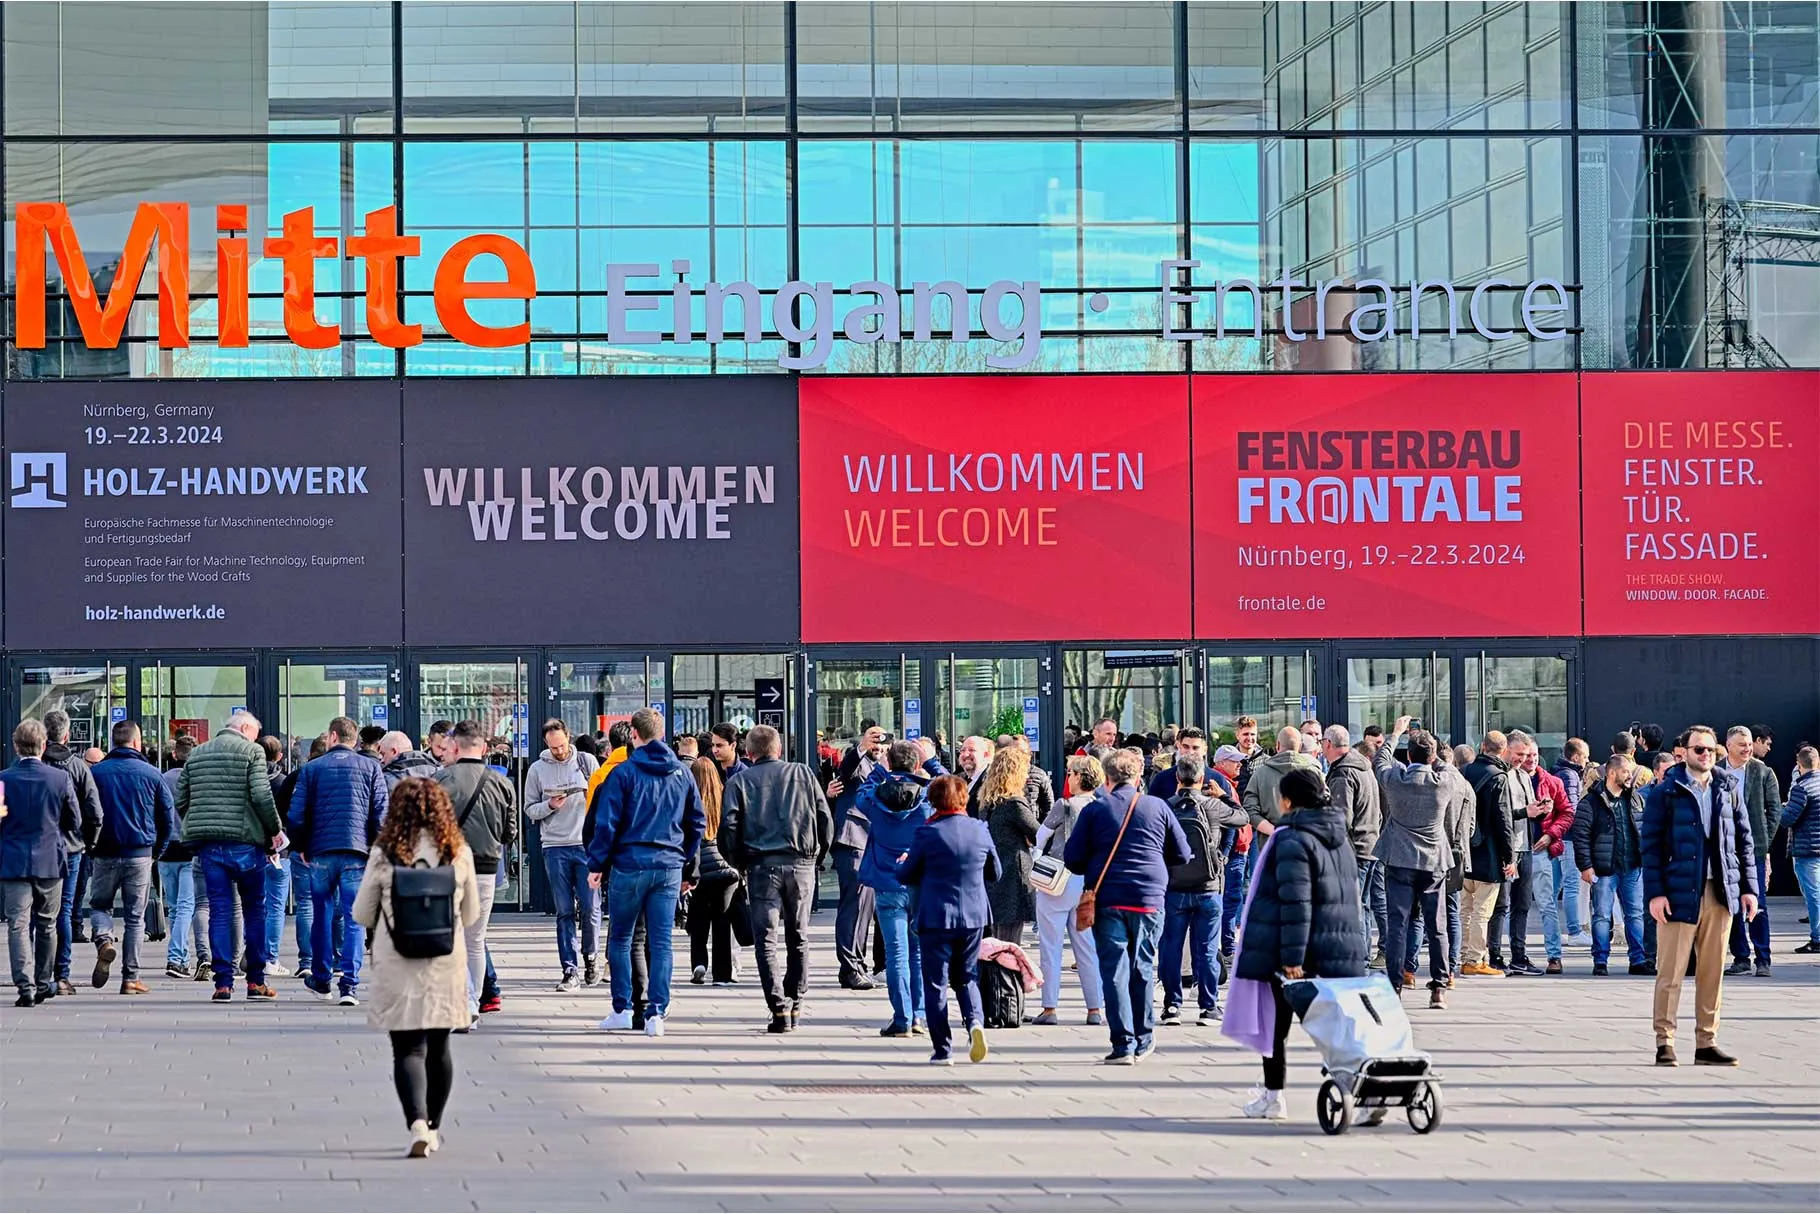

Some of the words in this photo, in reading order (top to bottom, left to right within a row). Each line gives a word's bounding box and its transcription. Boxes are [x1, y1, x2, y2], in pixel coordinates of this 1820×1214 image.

[15, 202, 536, 349] Mitte
[606, 259, 1041, 370] Eingang
[1161, 259, 1569, 342] Entrance
[83, 403, 150, 420] Nürnberg,
[154, 403, 215, 420] Germany
[1624, 421, 1674, 449] DIE
[1686, 421, 1793, 449] MESSE.
[1237, 430, 1521, 471] FENSTERBAU
[83, 466, 369, 497] HOLZ-HANDWERK
[424, 466, 775, 506] WILLKOMMEN
[843, 452, 1144, 493] WILLKOMMEN
[1625, 458, 1763, 486] FENSTER.
[1237, 475, 1523, 525] FRONTALE
[1622, 490, 1690, 524] TÜR.
[84, 517, 145, 530] Europäische
[147, 517, 201, 529] Fachmesse
[203, 516, 219, 529] für
[220, 515, 335, 530] Maschinentechnologie
[468, 499, 731, 541] WELCOME
[844, 507, 1058, 547] WELCOME
[84, 535, 104, 545] und
[107, 532, 193, 546] Fertigungsbedarf
[1625, 532, 1768, 561] FASSADE.
[84, 557, 132, 569] European
[135, 556, 163, 567] Trade
[165, 556, 183, 567] Fair
[185, 555, 201, 567] for
[203, 555, 247, 567] Machine
[249, 555, 308, 568] Technology,
[311, 554, 366, 568] Equipment
[1238, 545, 1354, 570] Nürnberg,
[84, 572, 104, 583] and
[106, 571, 148, 585] Supplies
[150, 571, 166, 583] for
[168, 571, 185, 583] the
[187, 571, 219, 583] Wood
[221, 570, 251, 583] Crafts
[1625, 574, 1647, 585] THE
[1650, 574, 1685, 585] TRADE
[1688, 573, 1726, 585] SHOW.
[1237, 595, 1326, 611] frontale.de
[1625, 589, 1681, 601] WINDOW.
[1684, 589, 1721, 601] DOOR.
[1724, 589, 1769, 601] FACADE.
[85, 604, 225, 621] holz-handwerk.de
